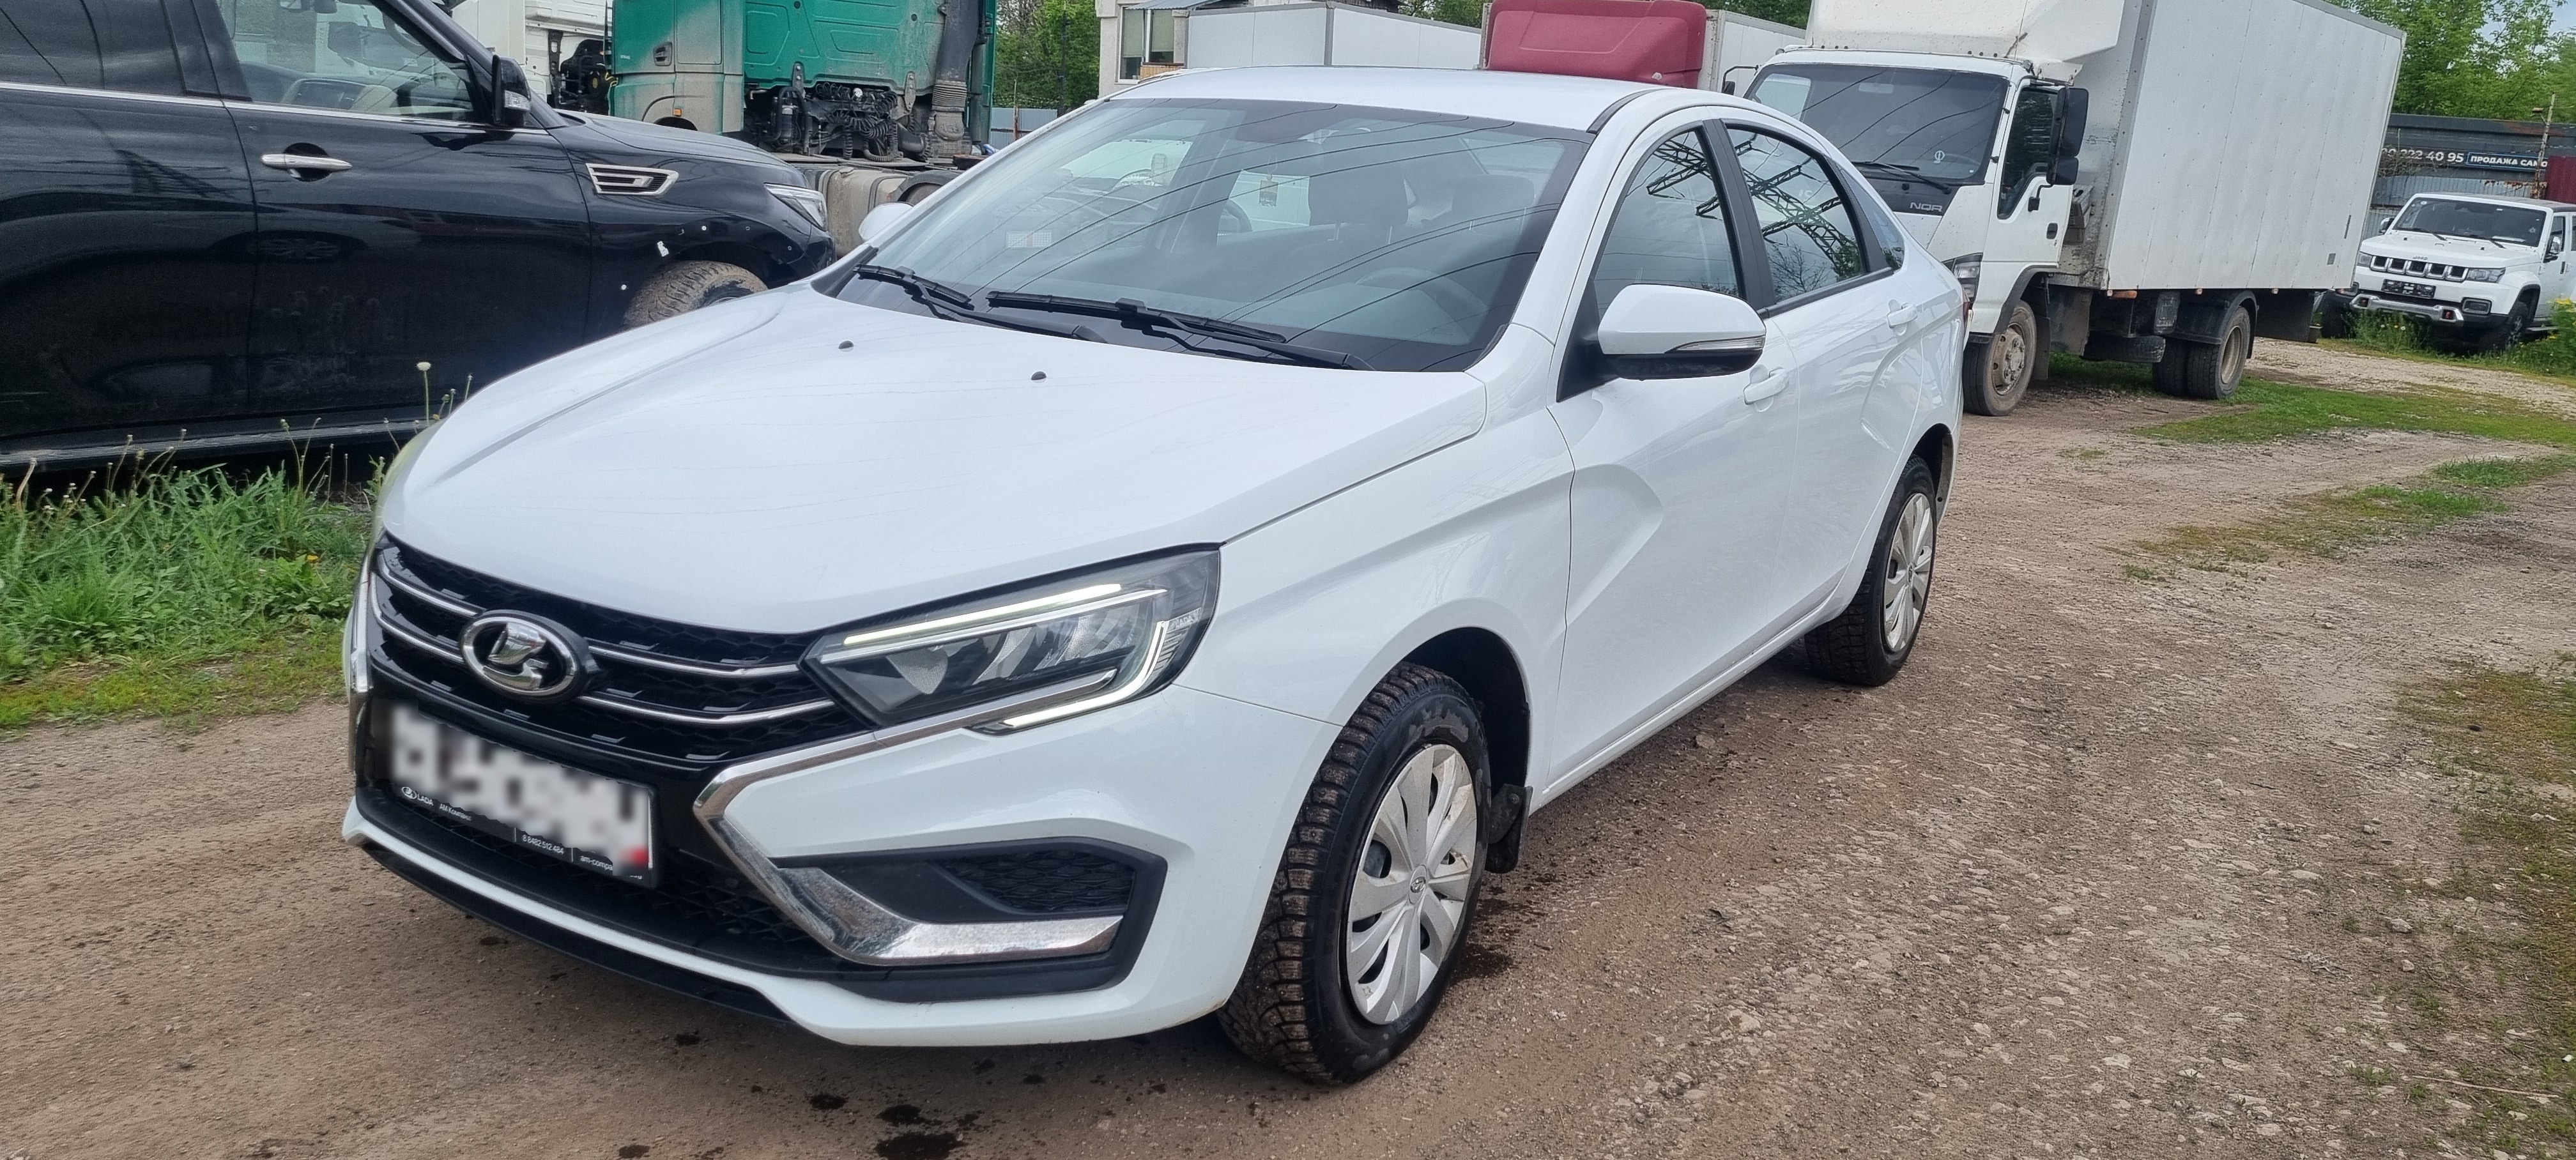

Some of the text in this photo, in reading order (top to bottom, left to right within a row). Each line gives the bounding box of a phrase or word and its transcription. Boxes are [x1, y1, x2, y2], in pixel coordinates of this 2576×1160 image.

[2425, 151, 2444, 161] 40
[2447, 153, 2464, 163] 95
[2470, 155, 2518, 165] ПРОДАЖА
[1910, 202, 1943, 212] NQR
[417, 793, 433, 805] LADA
[527, 836, 542, 847] 8482
[542, 841, 552, 851] 512
[553, 845, 564, 855] 484
